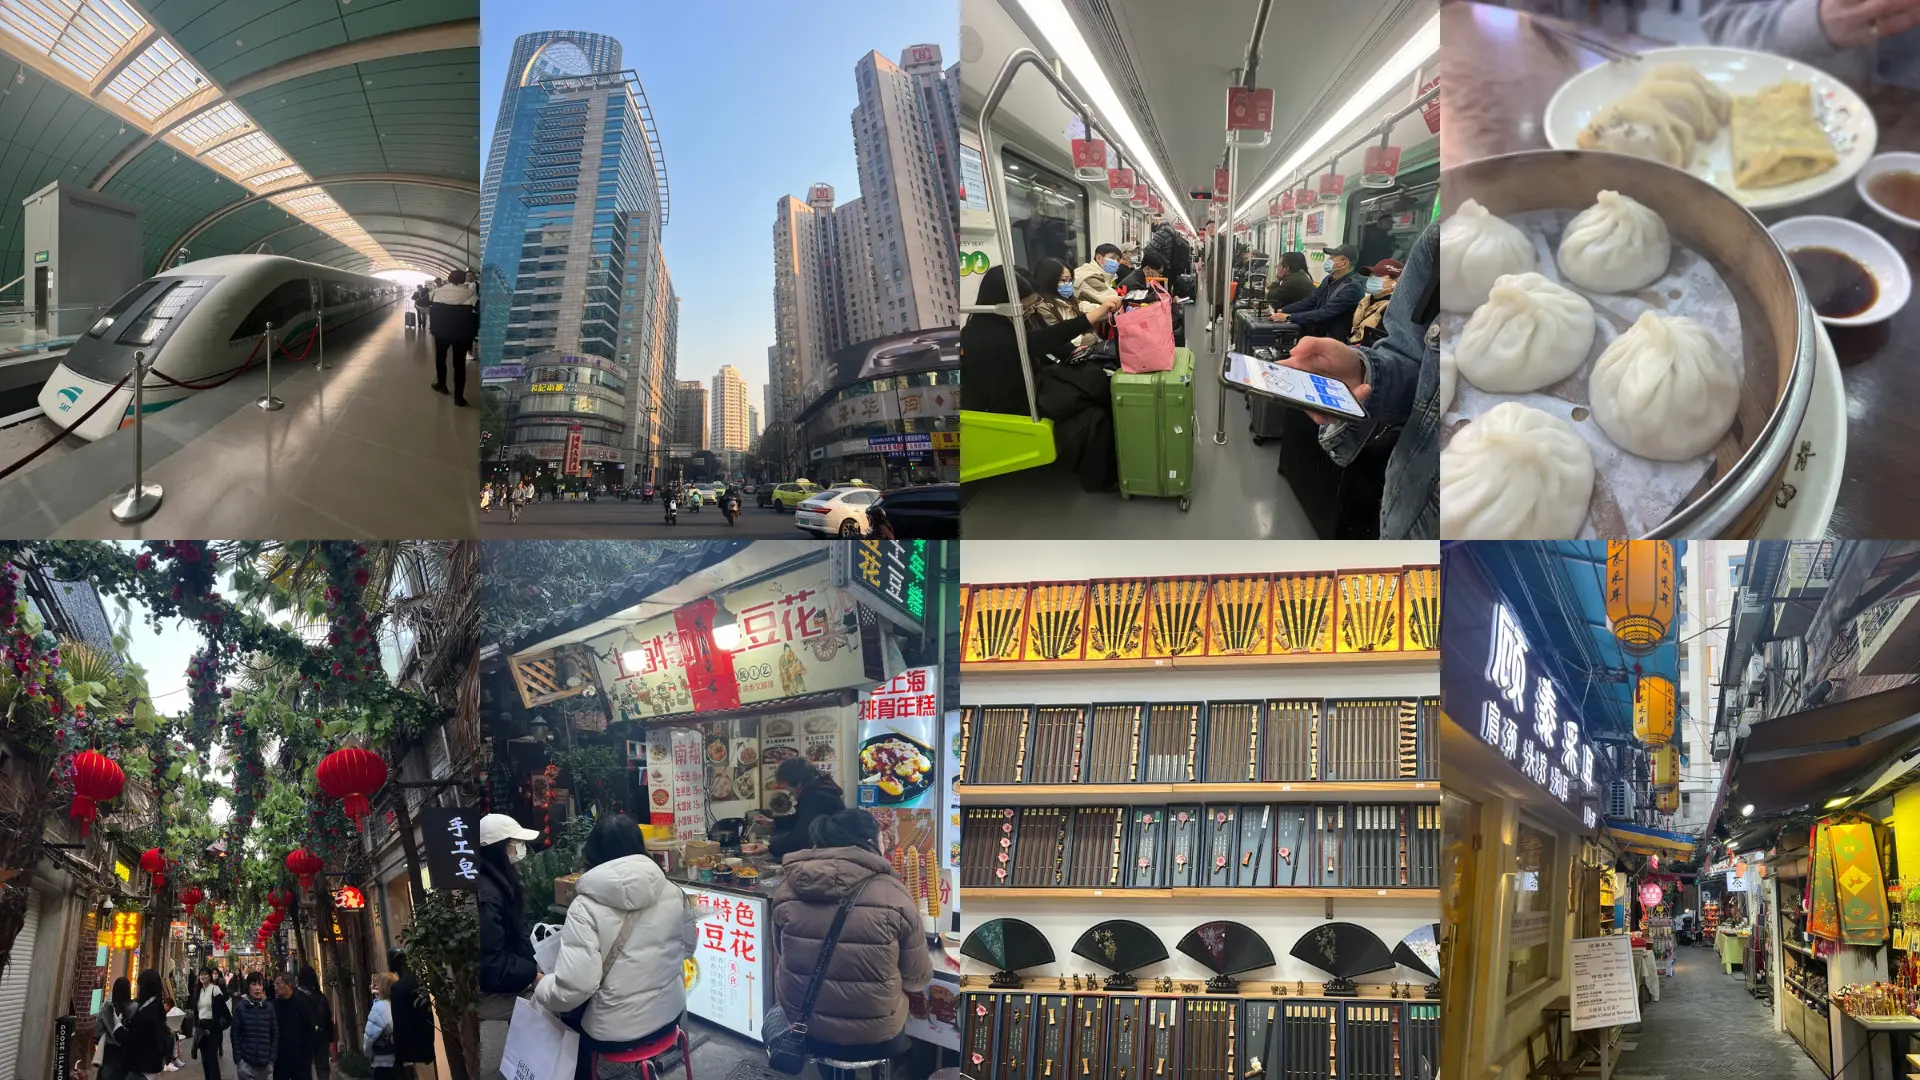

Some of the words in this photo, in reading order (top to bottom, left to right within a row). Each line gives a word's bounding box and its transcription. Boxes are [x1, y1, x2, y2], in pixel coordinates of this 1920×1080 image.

[58, 402, 72, 413] SMT
[859, 694, 936, 720] 排骨年糕
[1485, 603, 1595, 791] 顾泰采耳
[1480, 700, 1518, 760] 肩颈
[674, 742, 701, 765] 南翔
[448, 816, 478, 879] 手工皂
[695, 921, 756, 962] 豆花
